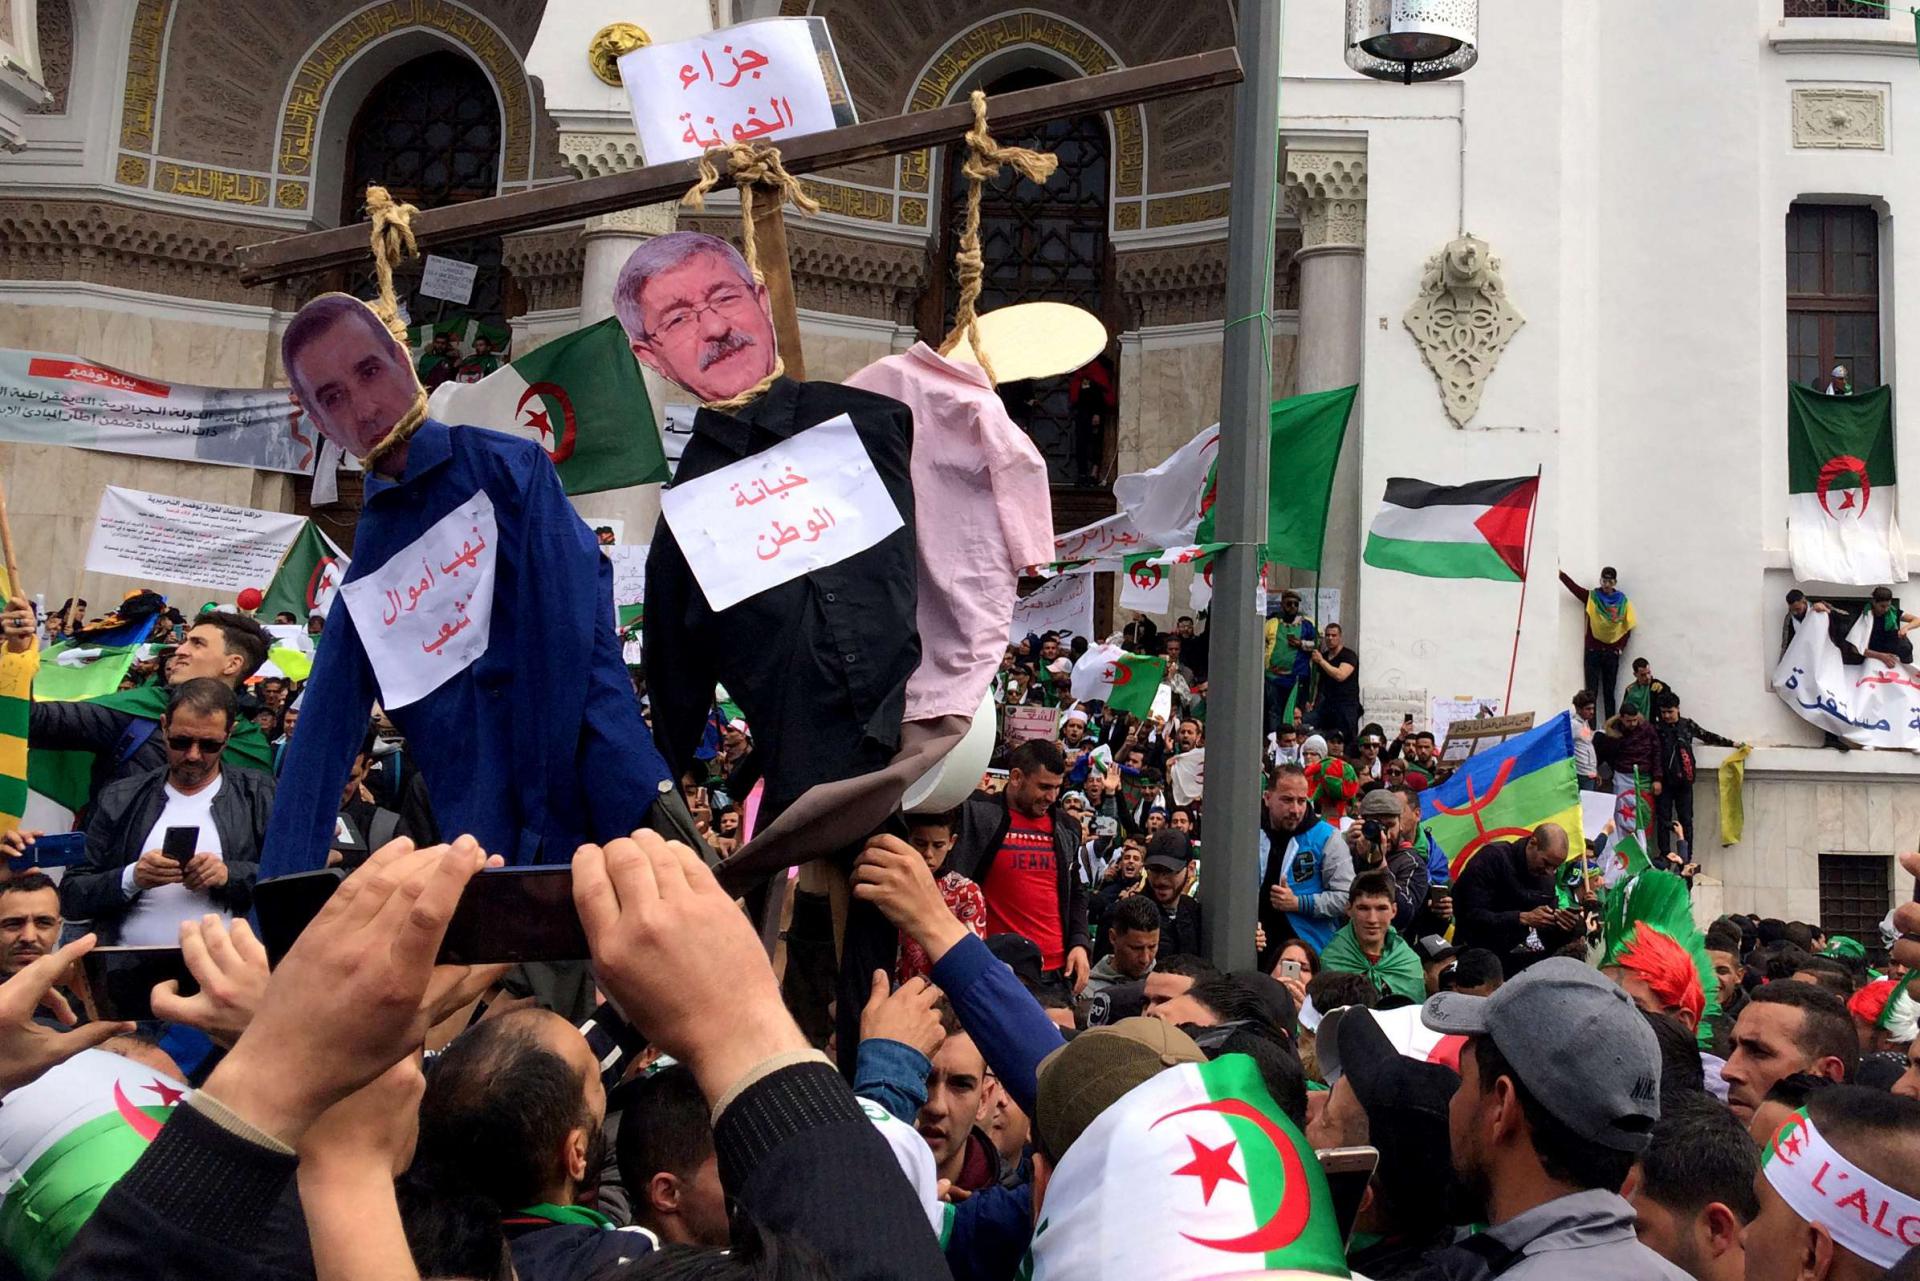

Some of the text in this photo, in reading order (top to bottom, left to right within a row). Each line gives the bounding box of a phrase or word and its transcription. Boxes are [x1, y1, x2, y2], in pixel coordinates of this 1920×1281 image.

[678, 44, 770, 91] جزاء
[678, 95, 795, 149] الخونة
[63, 367, 137, 390] بيان نوفمبر
[98, 414, 136, 428] ضمن
[136, 418, 190, 435] السيادة
[729, 465, 810, 508] خيانة
[756, 505, 837, 563] الوطن
[382, 526, 487, 626] نهب أموال
